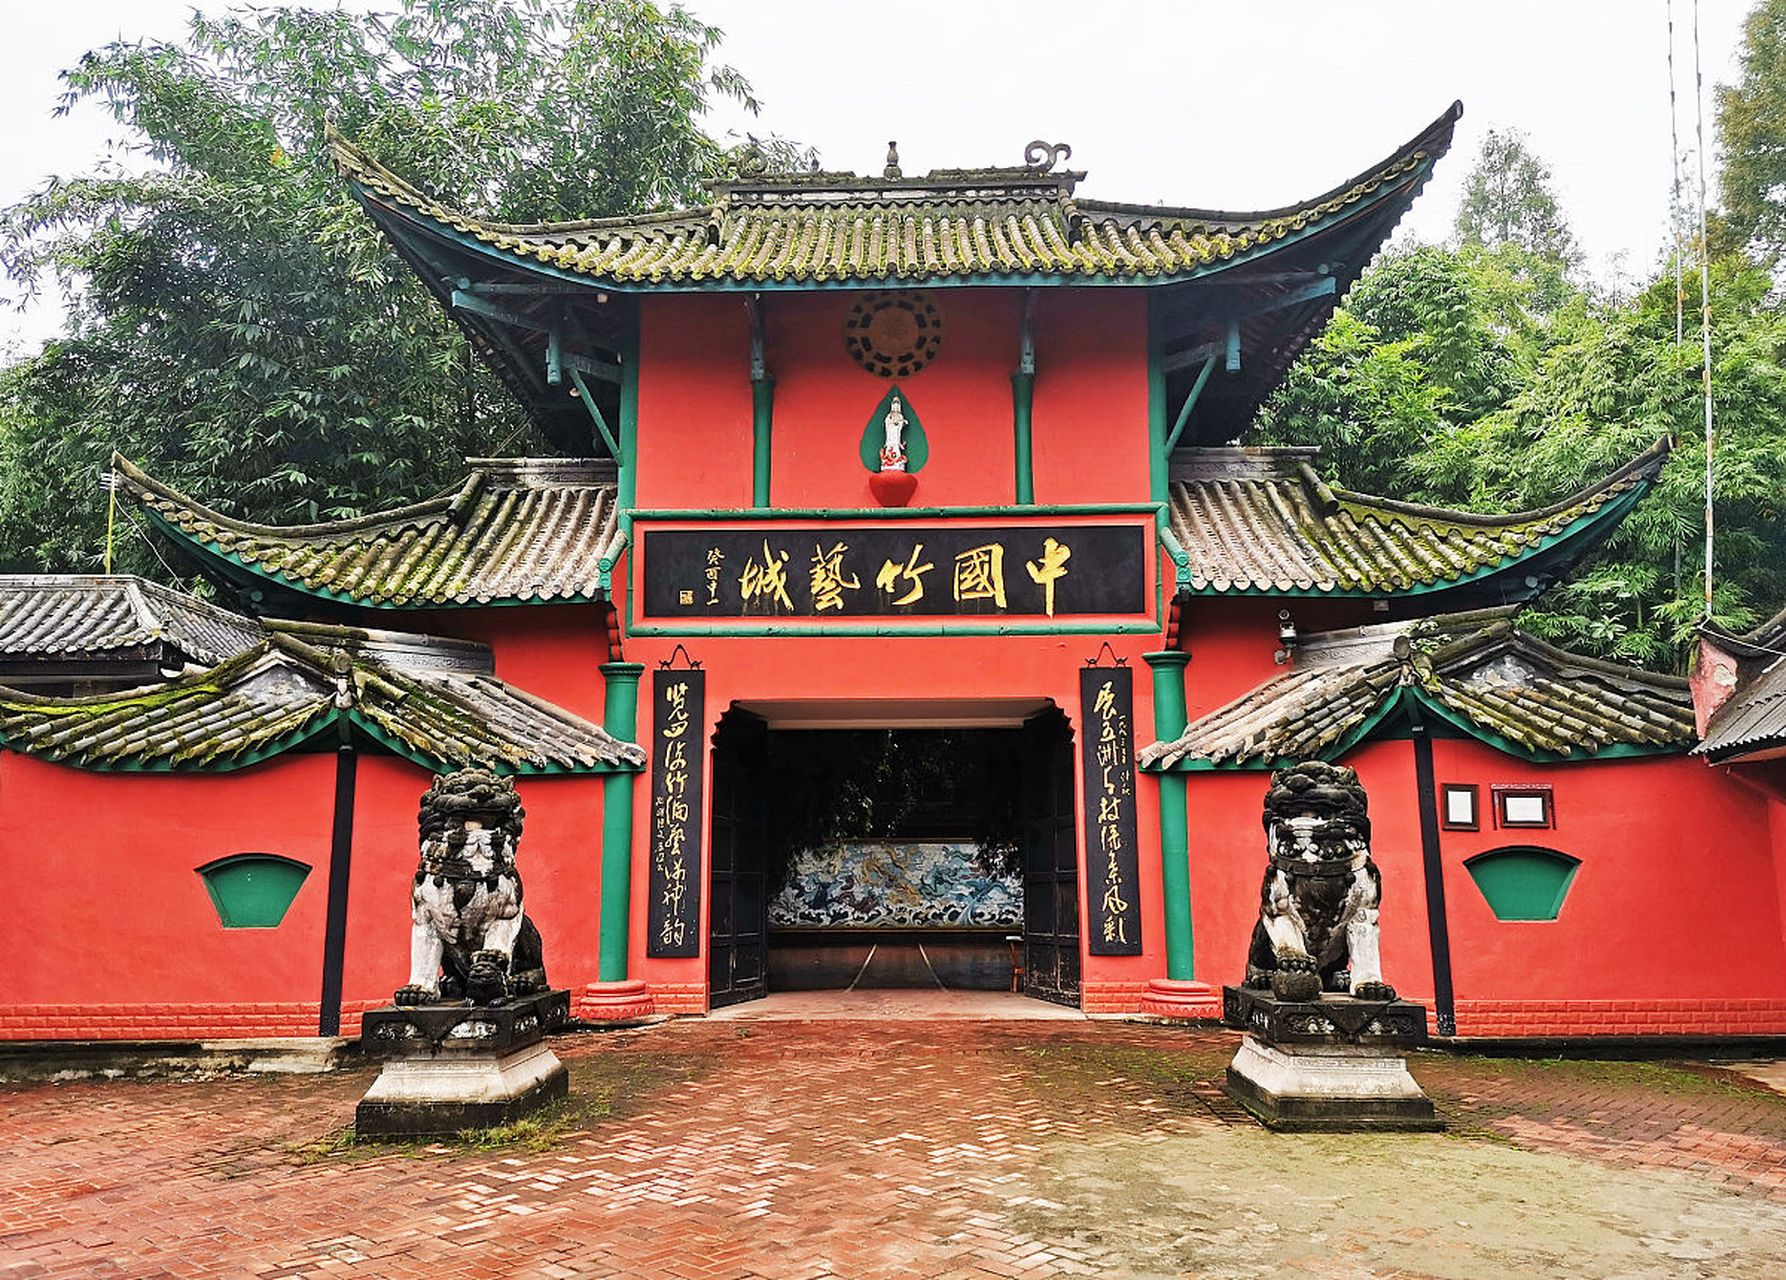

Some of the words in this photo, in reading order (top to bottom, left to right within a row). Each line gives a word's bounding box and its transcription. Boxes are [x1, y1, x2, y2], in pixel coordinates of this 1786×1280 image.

[737, 537, 1072, 618] 中國竹藝城
